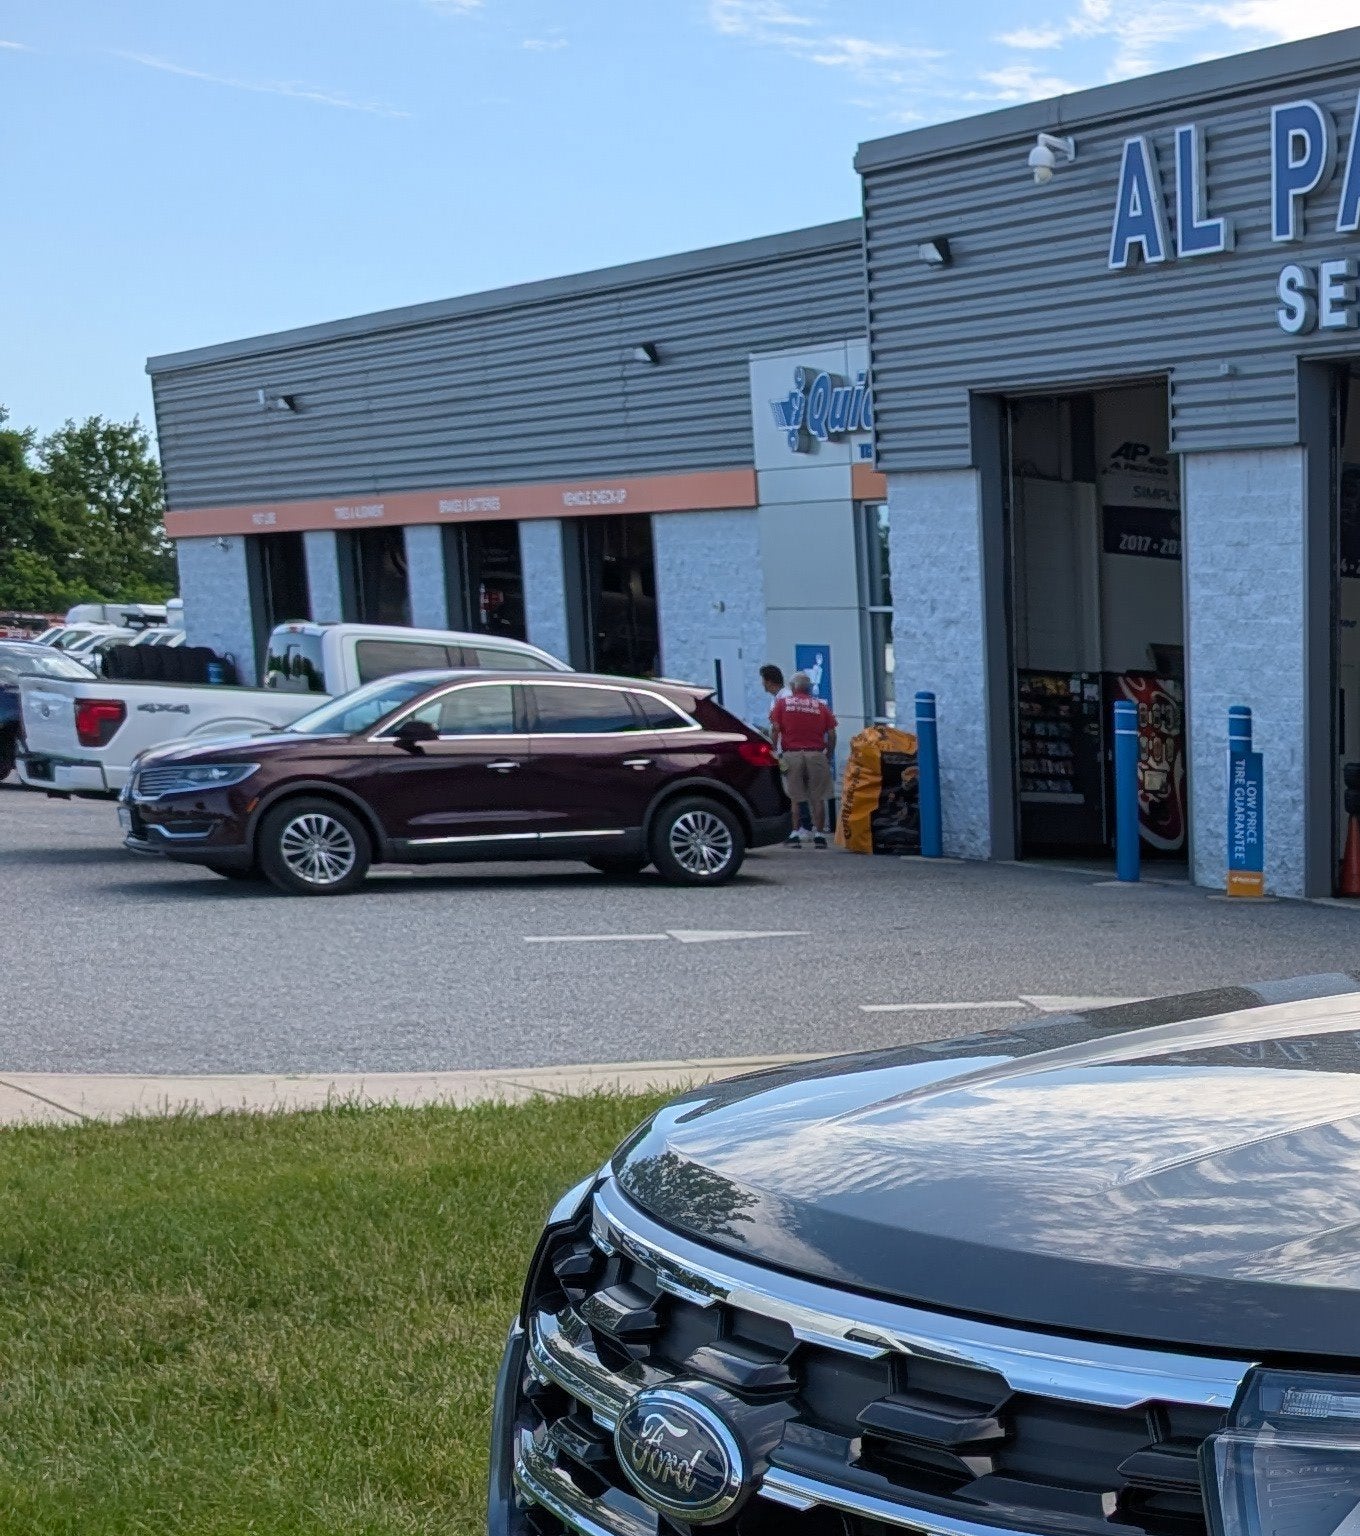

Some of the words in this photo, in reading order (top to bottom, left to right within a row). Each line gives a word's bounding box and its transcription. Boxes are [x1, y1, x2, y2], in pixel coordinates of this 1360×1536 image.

[1108, 124, 1232, 271] AL
[1159, 538, 1180, 555] 20
[1234, 758, 1246, 785] TIRE
[1246, 780, 1258, 809] LOW
[1246, 811, 1258, 844] PRICE
[632, 1413, 703, 1494] Ford
